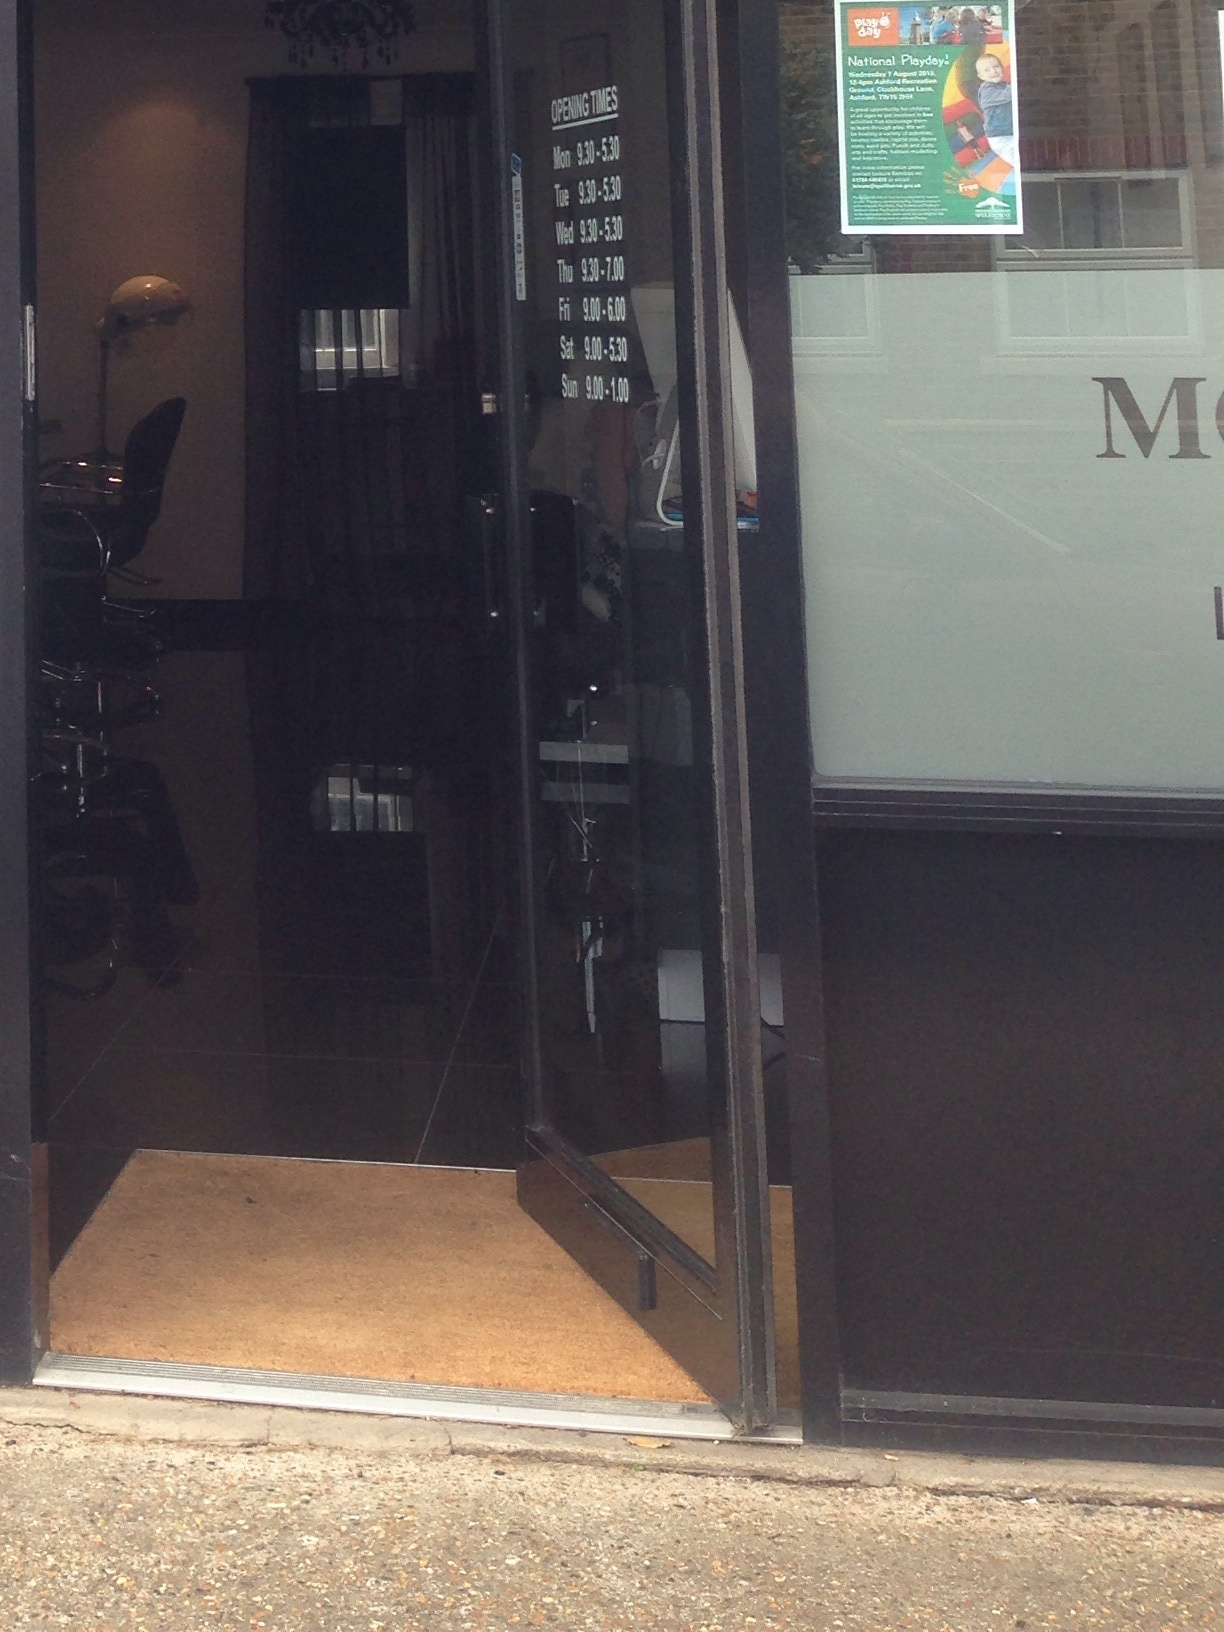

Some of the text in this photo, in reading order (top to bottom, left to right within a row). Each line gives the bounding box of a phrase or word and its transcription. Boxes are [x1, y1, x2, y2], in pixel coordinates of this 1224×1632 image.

[848, 54, 950, 68] National Playday!
[551, 85, 618, 124] OPENING TIMES
[553, 145, 571, 170] Mon
[577, 139, 595, 166] 9.30
[601, 135, 620, 162] 5.30
[554, 183, 570, 208] Tue
[578, 179, 596, 205] 9.30
[603, 175, 622, 202] 5.30
[959, 183, 979, 193] Free
[555, 221, 574, 246] Wed
[579, 218, 598, 244] 9.30
[604, 215, 623, 242] 5.30
[557, 259, 574, 283] Thu
[581, 257, 599, 283] 9.30
[606, 255, 624, 282] 7.00
[559, 297, 571, 322] Fri
[583, 297, 601, 322] 9.00
[607, 296, 626, 322] 6.00
[560, 335, 575, 360] Sat
[584, 336, 602, 361] 9.00
[609, 336, 627, 363] 5.30
[561, 373, 578, 399] Sun
[586, 375, 604, 401] 9.00
[611, 377, 629, 403] 1.00
[1091, 374, 1224, 460] M
